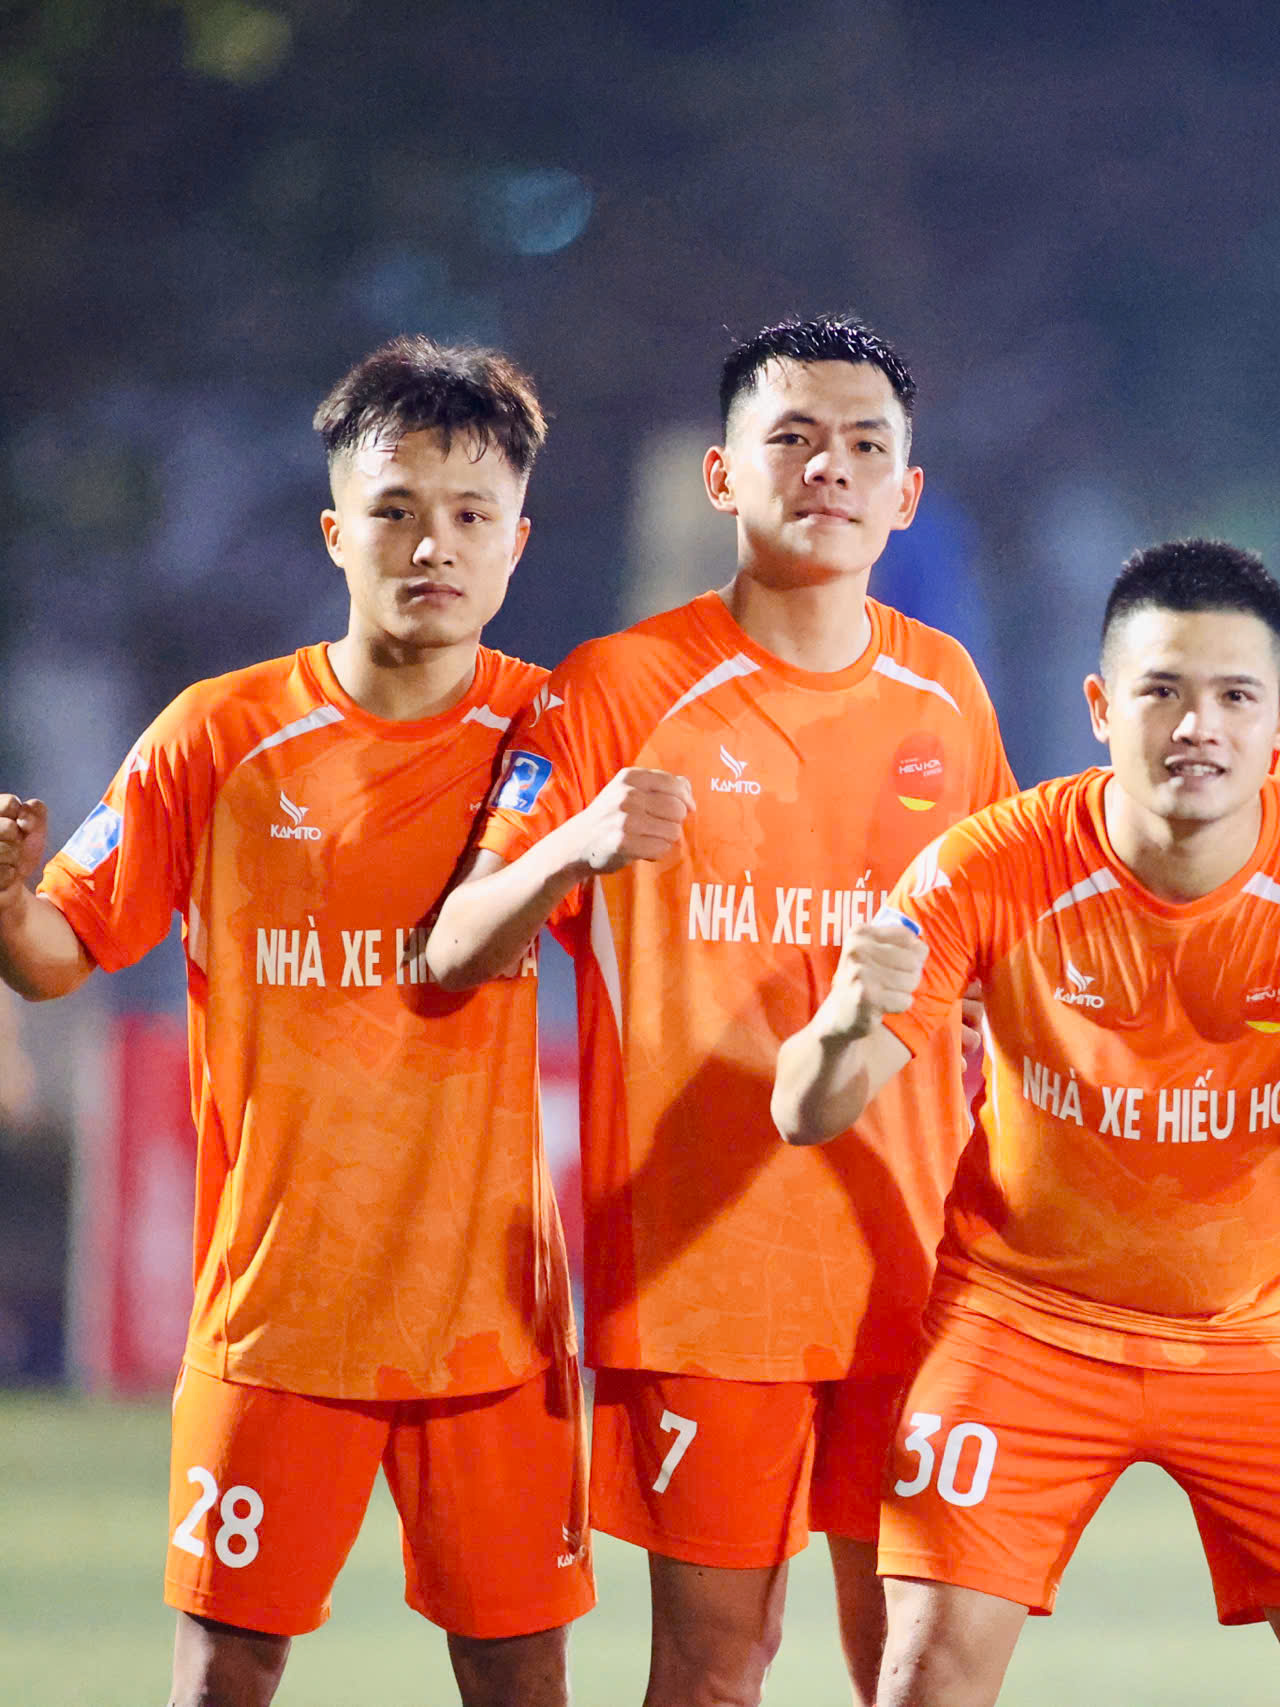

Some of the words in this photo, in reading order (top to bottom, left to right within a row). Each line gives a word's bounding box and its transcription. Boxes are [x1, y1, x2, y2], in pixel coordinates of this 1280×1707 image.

[711, 777, 761, 795] KAMITO
[270, 824, 321, 841] KAMITO
[688, 870, 759, 943] NHÀ
[772, 887, 812, 945] XE
[256, 915, 326, 987] NHÀ
[340, 929, 382, 987] XE
[1054, 986, 1104, 1009] KAMITO
[1023, 1056, 1083, 1126] NHÀ
[1099, 1086, 1144, 1140] XE
[1157, 1070, 1235, 1143] HIẾU
[652, 1410, 698, 1494] 7
[894, 1411, 998, 1508] 30
[173, 1465, 264, 1569] 28
